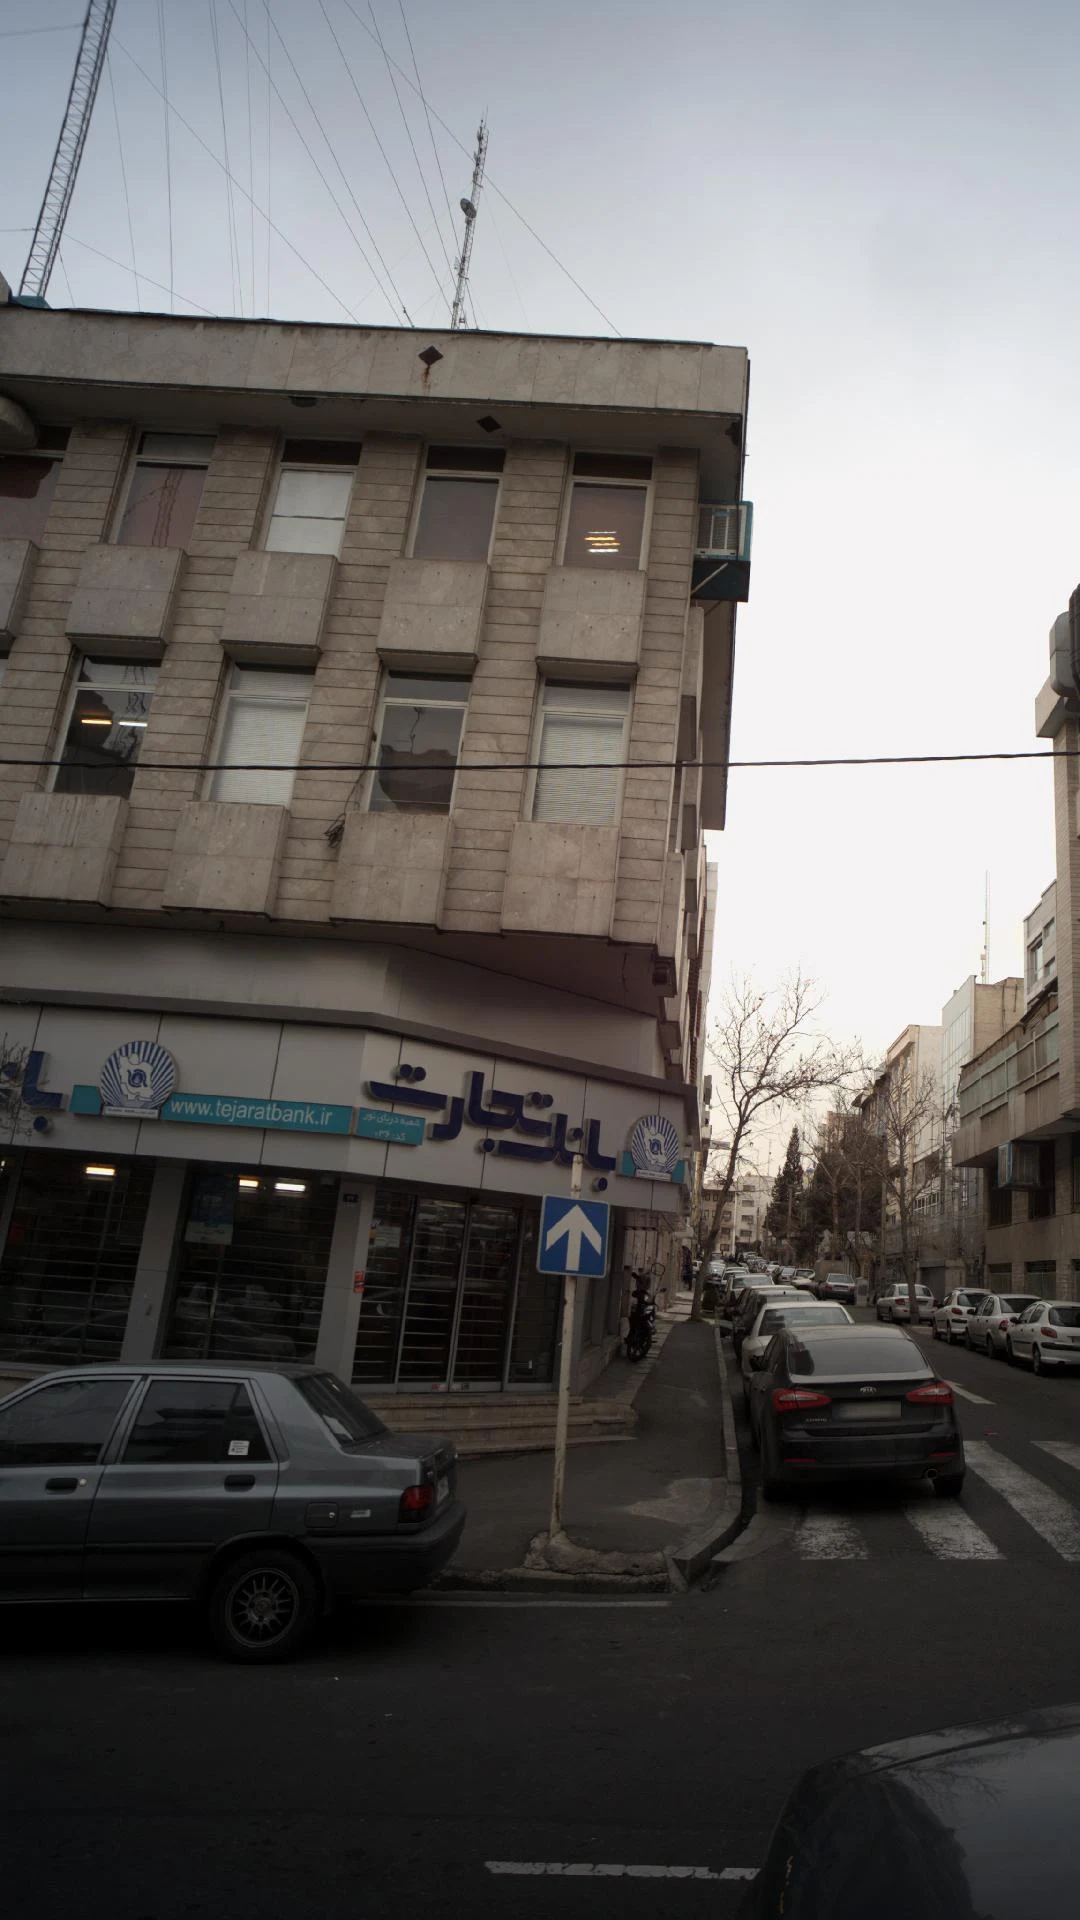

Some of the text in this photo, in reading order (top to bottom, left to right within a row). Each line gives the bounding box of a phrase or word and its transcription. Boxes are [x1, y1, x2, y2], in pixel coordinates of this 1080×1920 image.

[171, 1100, 333, 1125] www.tejaratbank.ir
[369, 1064, 617, 1191] بانک تجارت
